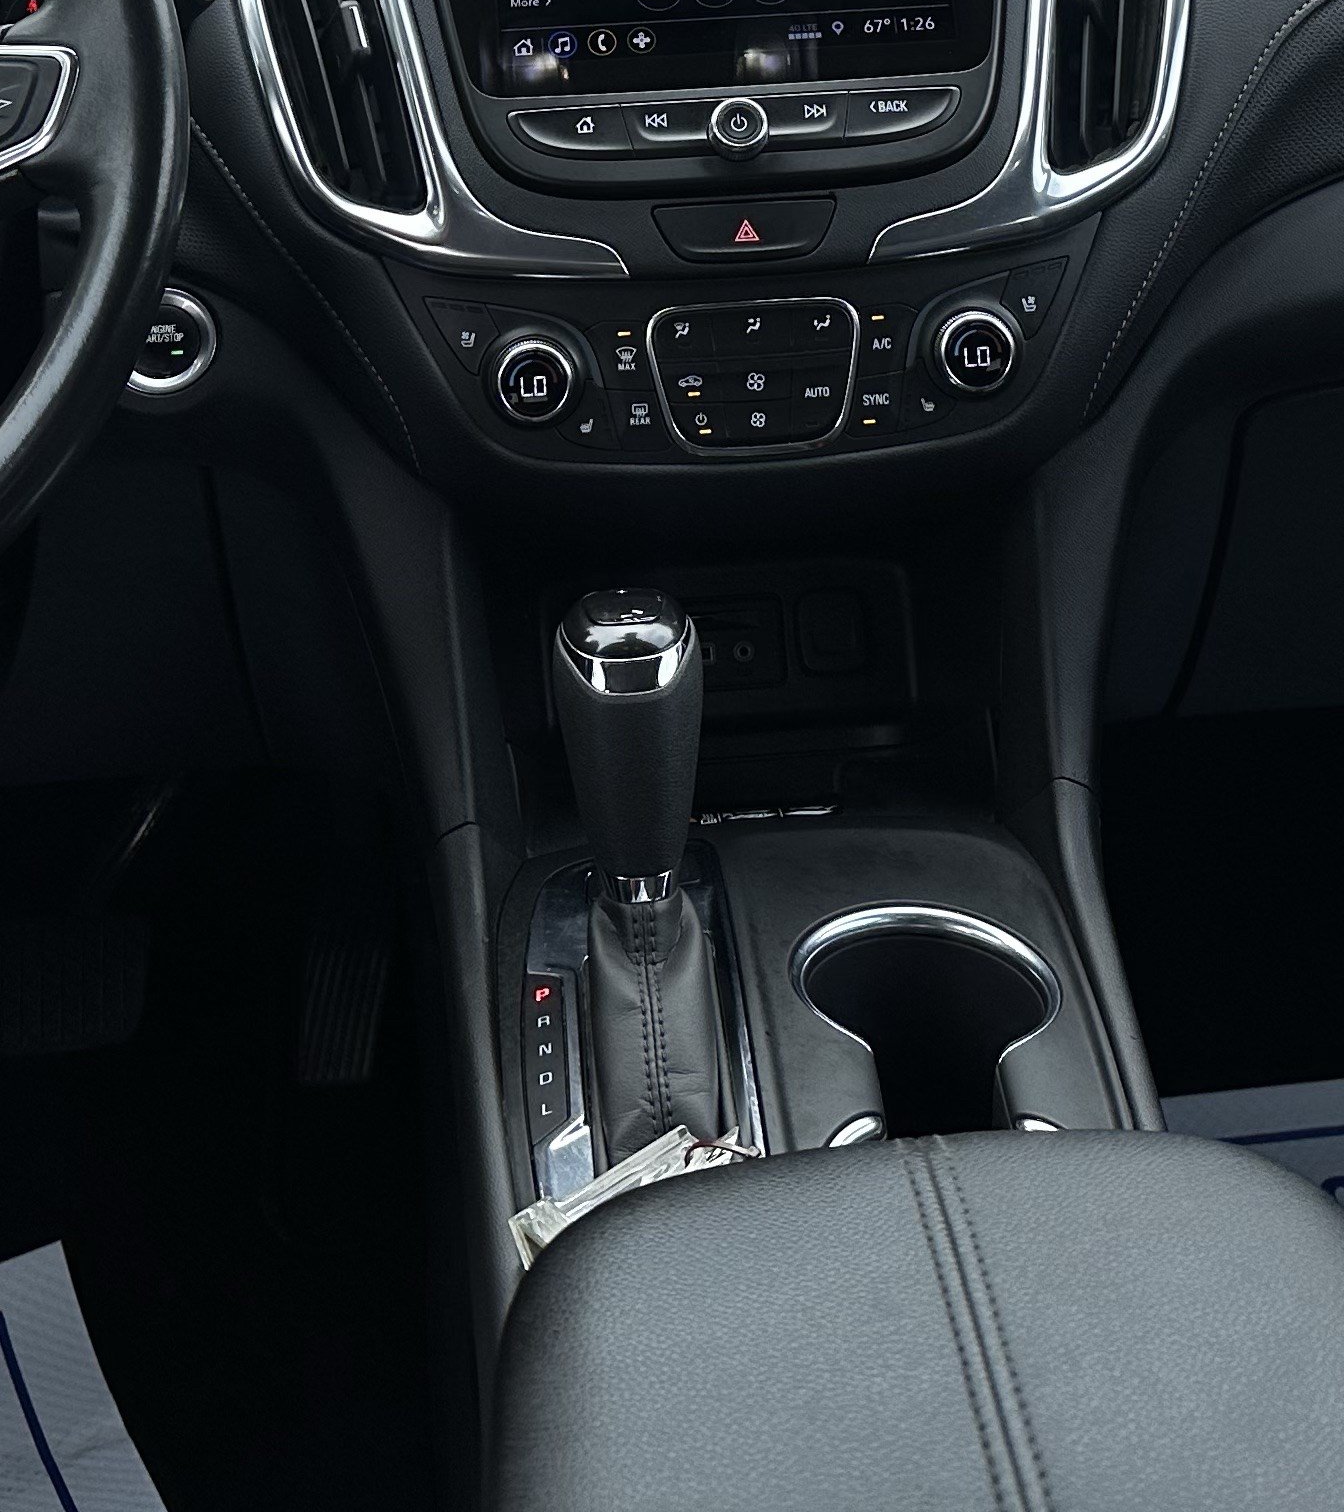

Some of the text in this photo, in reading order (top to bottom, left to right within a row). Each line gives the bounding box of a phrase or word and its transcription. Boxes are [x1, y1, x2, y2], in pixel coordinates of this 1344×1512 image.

[900, 16, 936, 31] 1:26
[877, 100, 909, 113] BACK
[150, 324, 177, 334] NGINE
[145, 332, 185, 344] ART/STOP
[872, 337, 892, 351] A/C
[963, 346, 991, 368] LO
[617, 362, 636, 371] MAX
[519, 375, 547, 397] LO
[804, 386, 830, 398] AUTO
[862, 393, 890, 406] SYNC
[629, 417, 651, 426] REAR
[535, 987, 550, 1002] P
[537, 1015, 550, 1028] R
[538, 1042, 552, 1056] N
[539, 1071, 553, 1086] D
[541, 1103, 553, 1116] L
